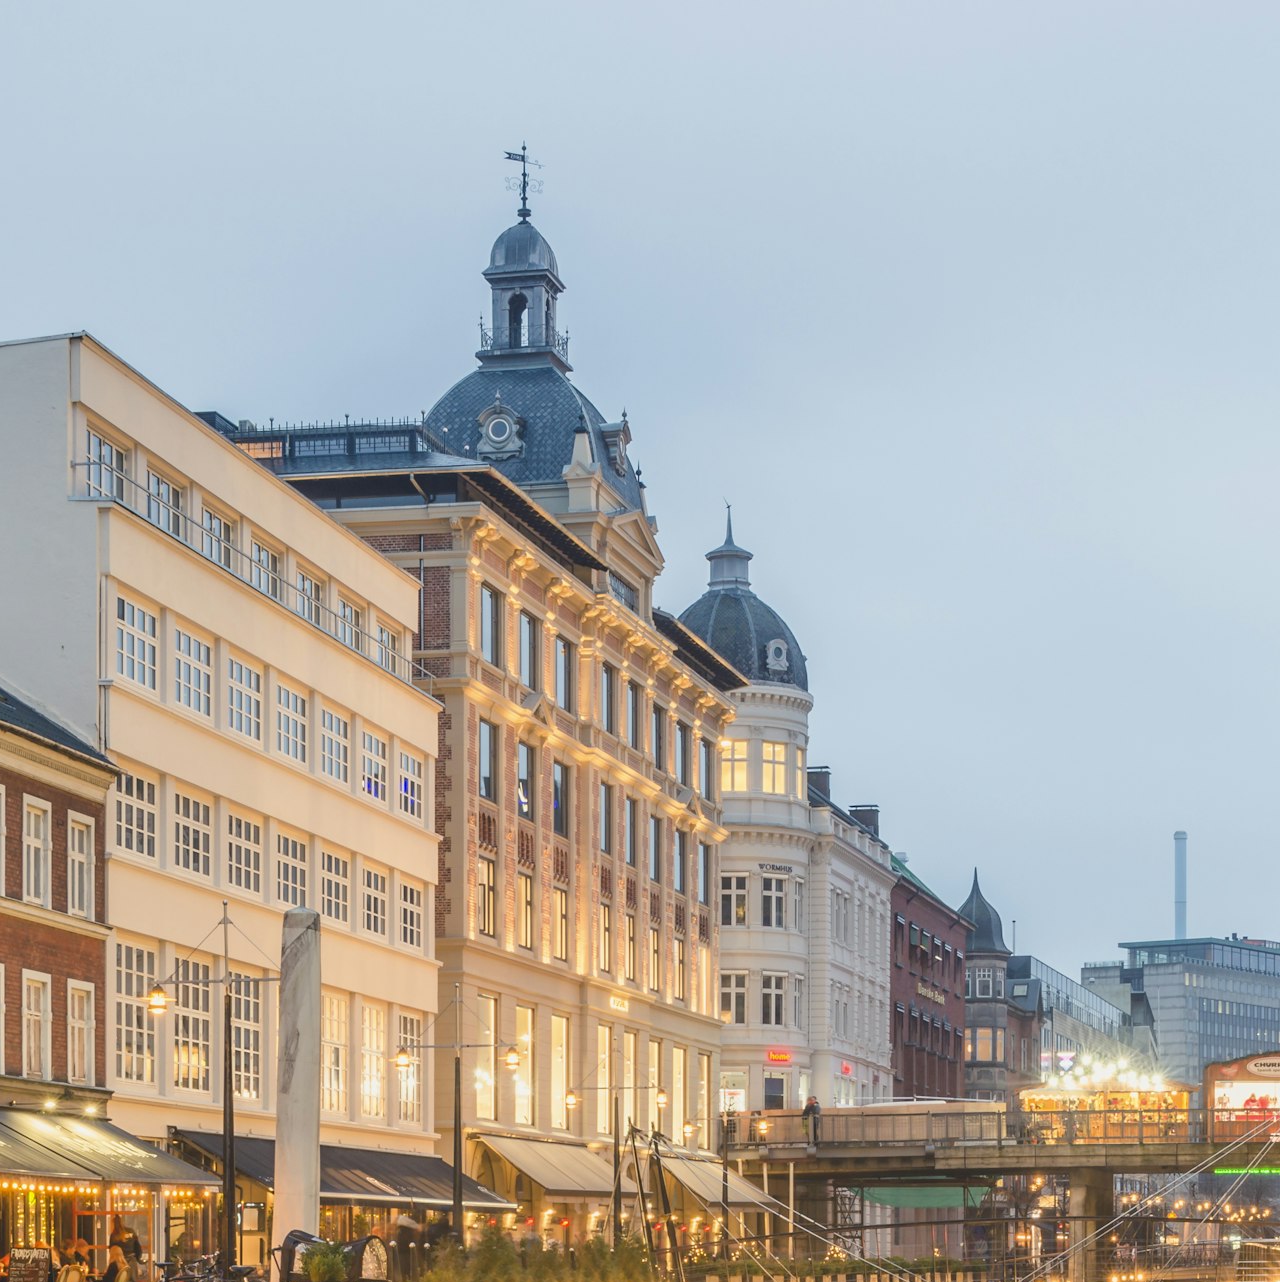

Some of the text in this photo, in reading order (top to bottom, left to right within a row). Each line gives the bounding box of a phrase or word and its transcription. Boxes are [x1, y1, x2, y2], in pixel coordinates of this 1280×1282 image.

[758, 863, 793, 873] WORMHUS
[917, 982, 946, 1005] Danske Bank
[769, 1050, 791, 1061] home
